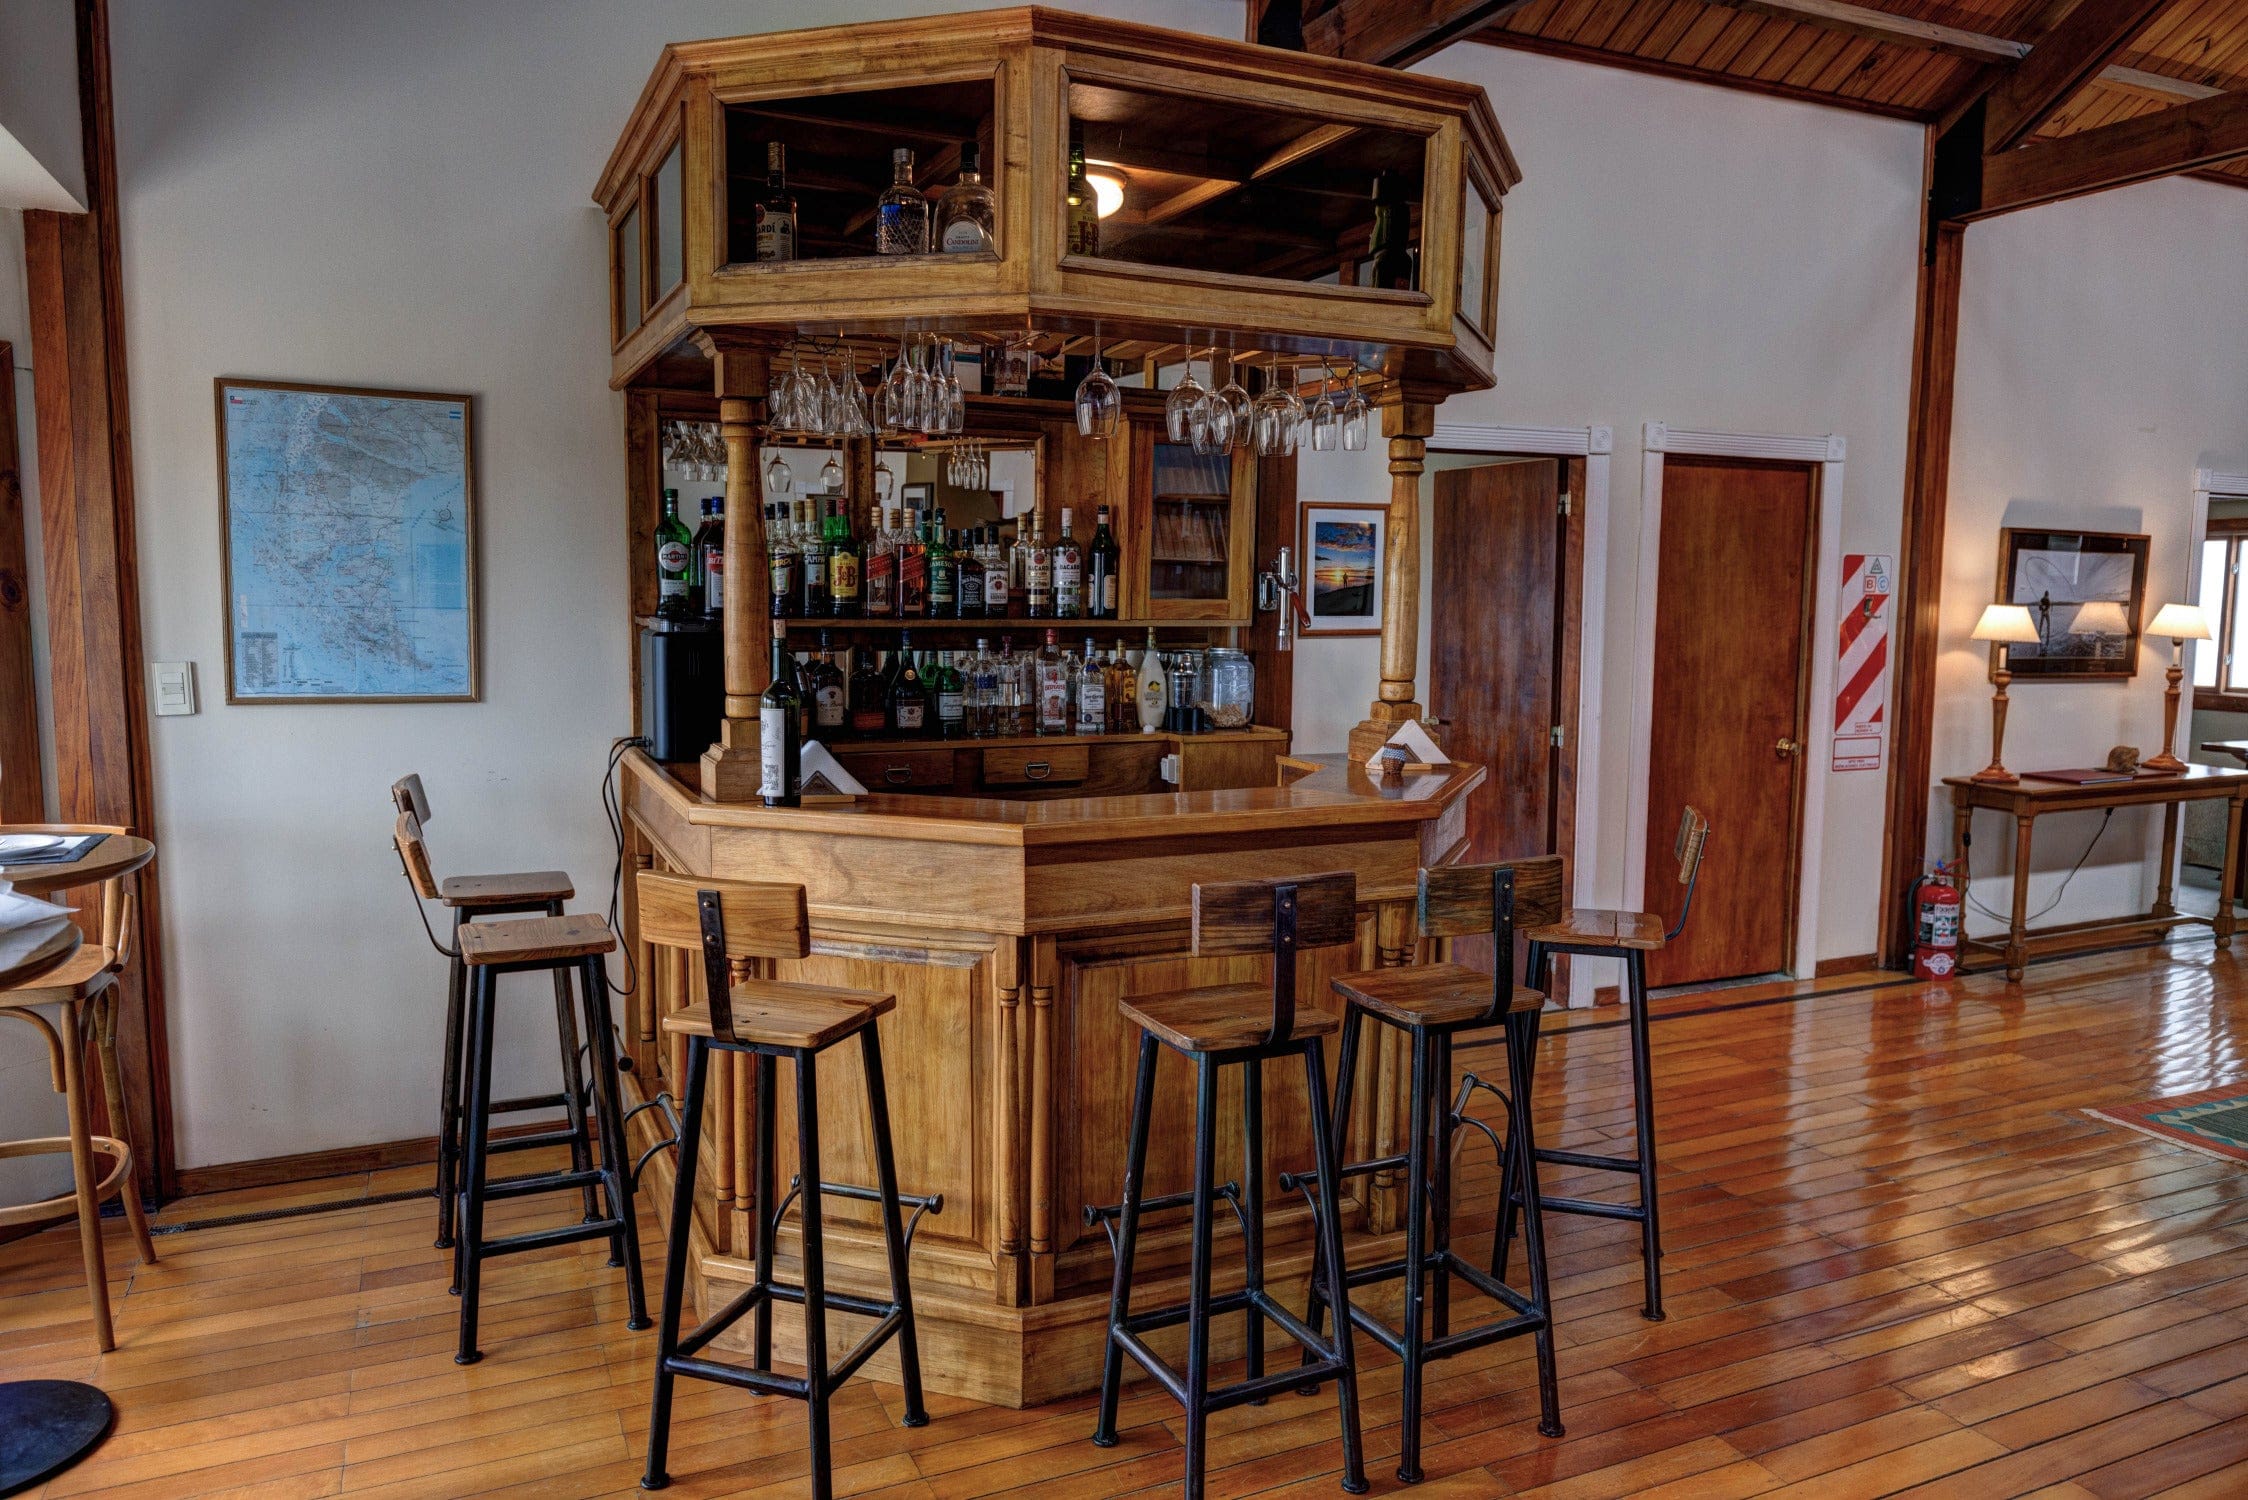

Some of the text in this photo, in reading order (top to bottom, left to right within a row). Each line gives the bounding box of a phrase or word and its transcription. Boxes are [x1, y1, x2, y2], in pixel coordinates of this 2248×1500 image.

[661, 553, 688, 561] MARTINI
[804, 555, 826, 564] CAMPA
[833, 565, 856, 588] J&B
[1867, 579, 1874, 589] B
